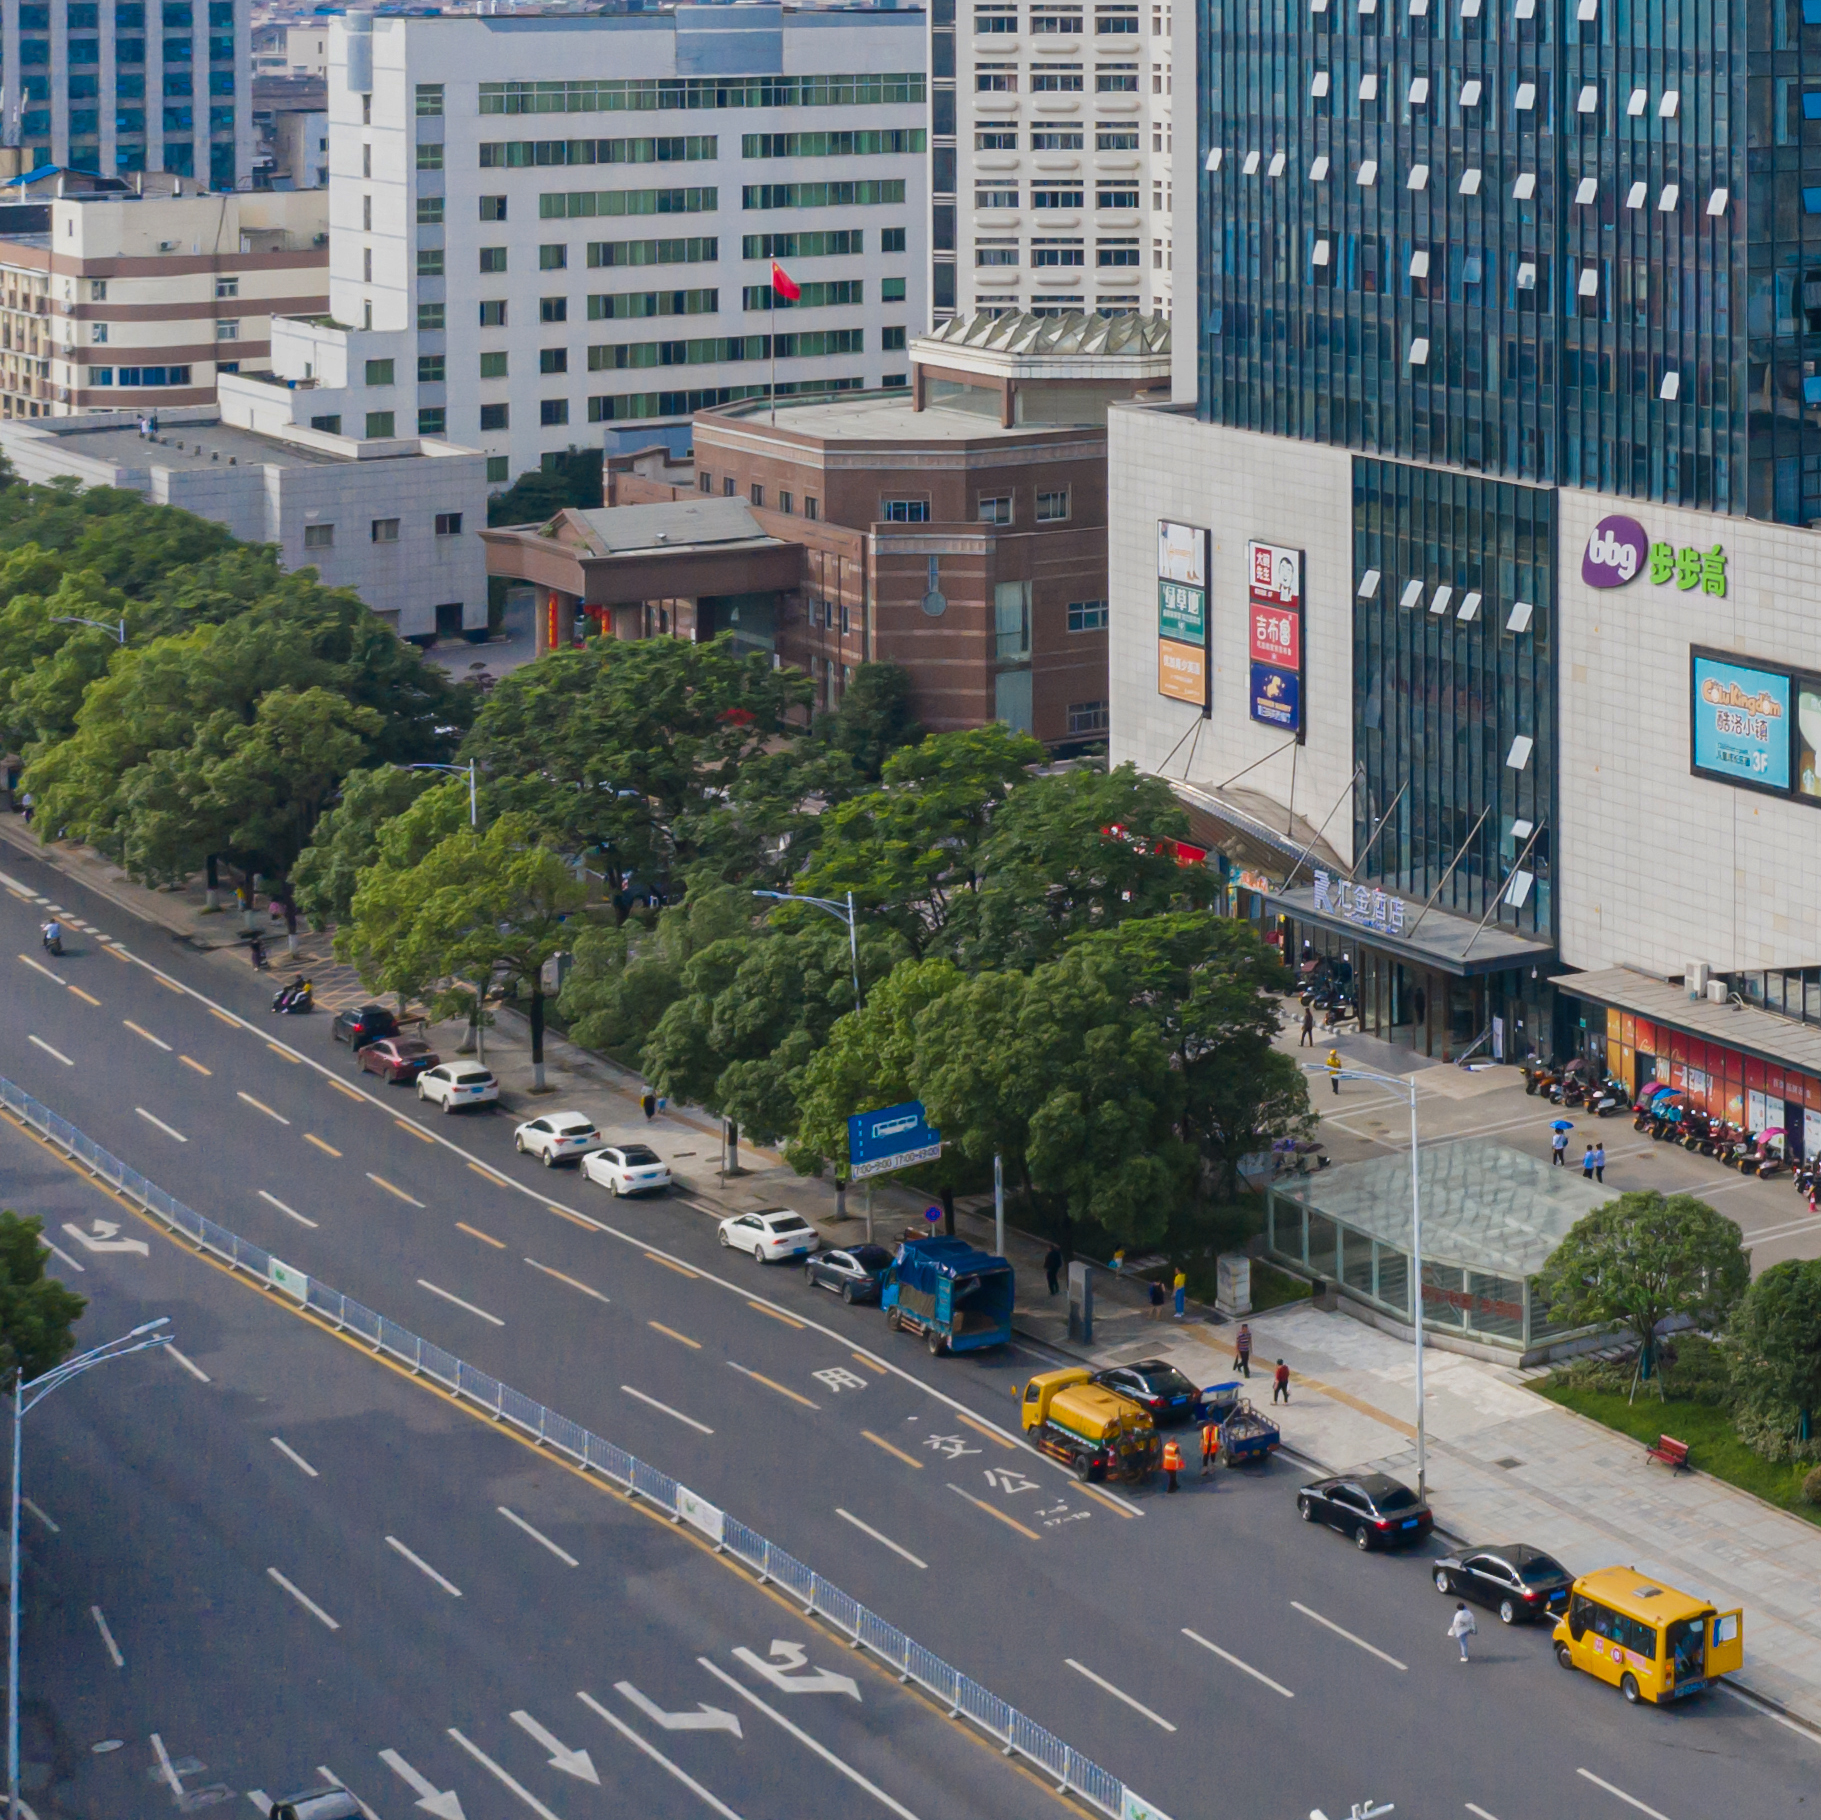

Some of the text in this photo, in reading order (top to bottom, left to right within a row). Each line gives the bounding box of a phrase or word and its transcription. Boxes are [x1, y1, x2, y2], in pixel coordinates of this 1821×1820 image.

[1589, 527, 1637, 581] bbg
[1650, 541, 1728, 598] 步步高
[1753, 750, 1769, 773] 3F
[1338, 878, 1405, 928] 汇金酒店
[922, 1434, 983, 1460] 交
[983, 1467, 1041, 1494] 公
